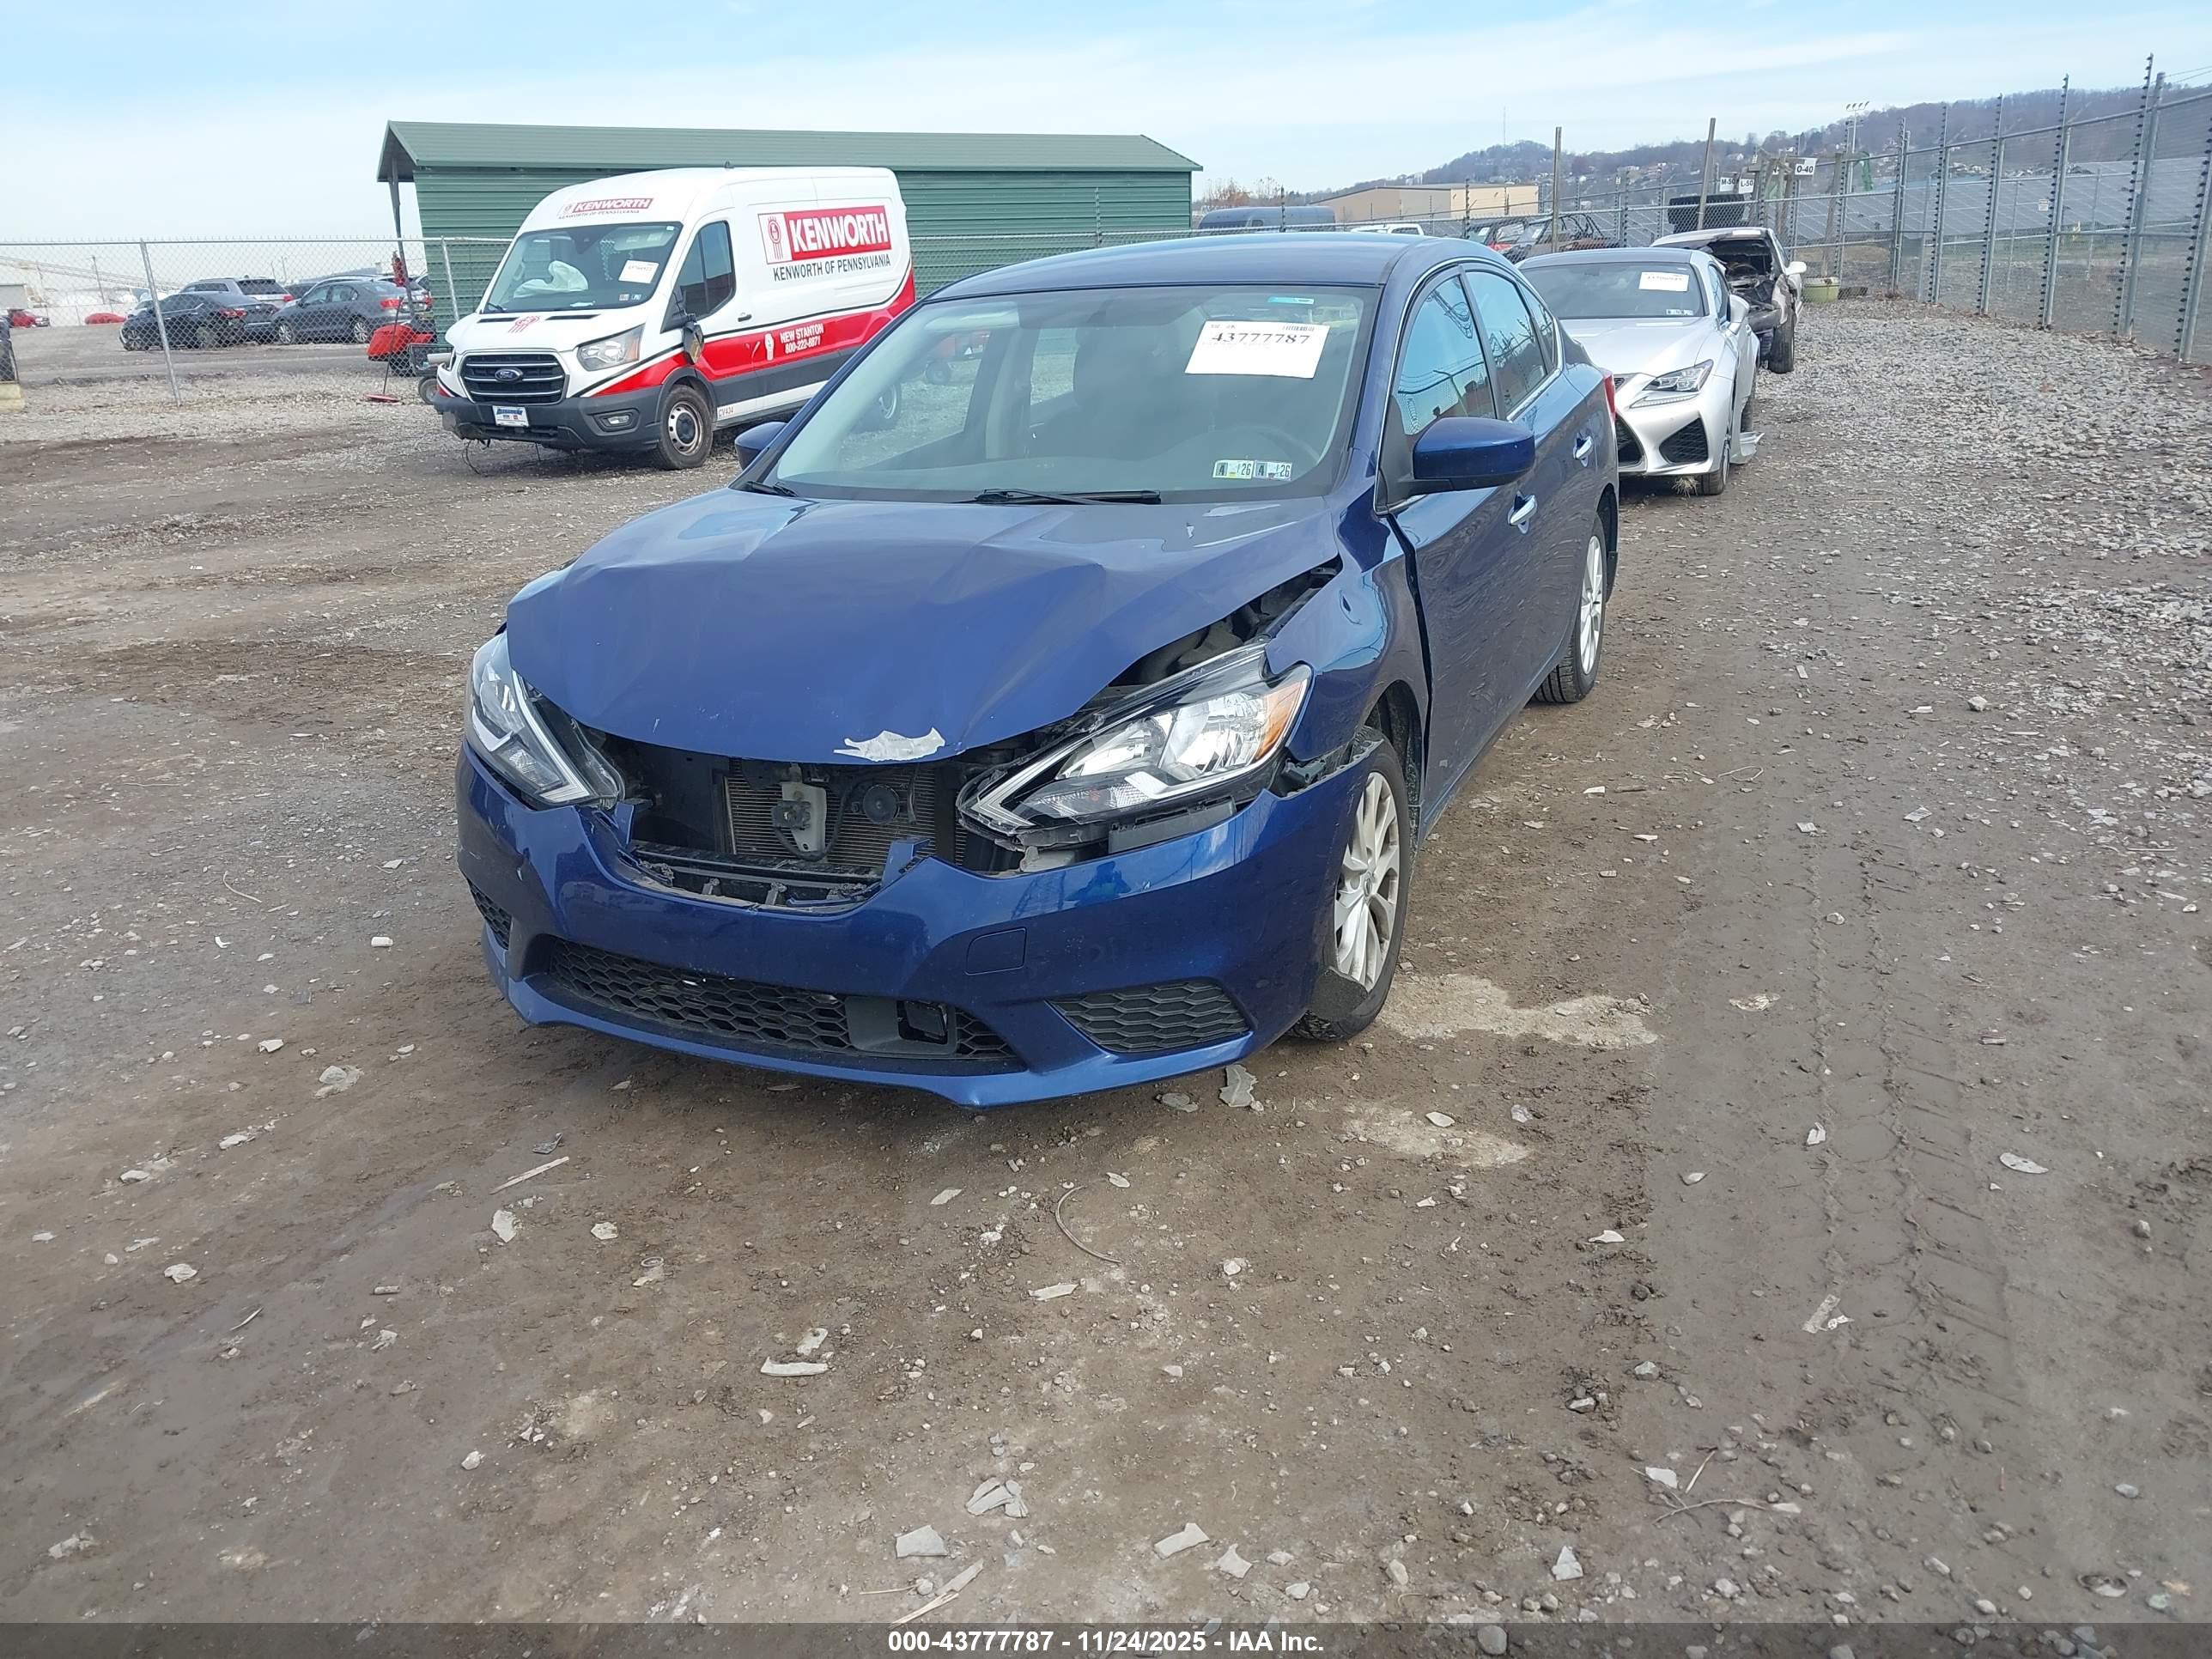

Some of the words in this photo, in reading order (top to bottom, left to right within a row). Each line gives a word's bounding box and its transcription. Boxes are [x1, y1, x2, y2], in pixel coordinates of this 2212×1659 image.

[1796, 165, 1814, 173] O-40
[574, 198, 650, 211] KENWORTH
[788, 212, 889, 252] KENWORTH
[773, 262, 823, 282] KENWORTH
[824, 261, 836, 274] OF
[837, 253, 891, 272] PENNSYLVANIA
[780, 330, 795, 344] NEW
[795, 323, 824, 340] STANTON
[1212, 332, 1310, 343] 43777787
[1241, 463, 1252, 477] 26
[1279, 464, 1291, 477] 26
